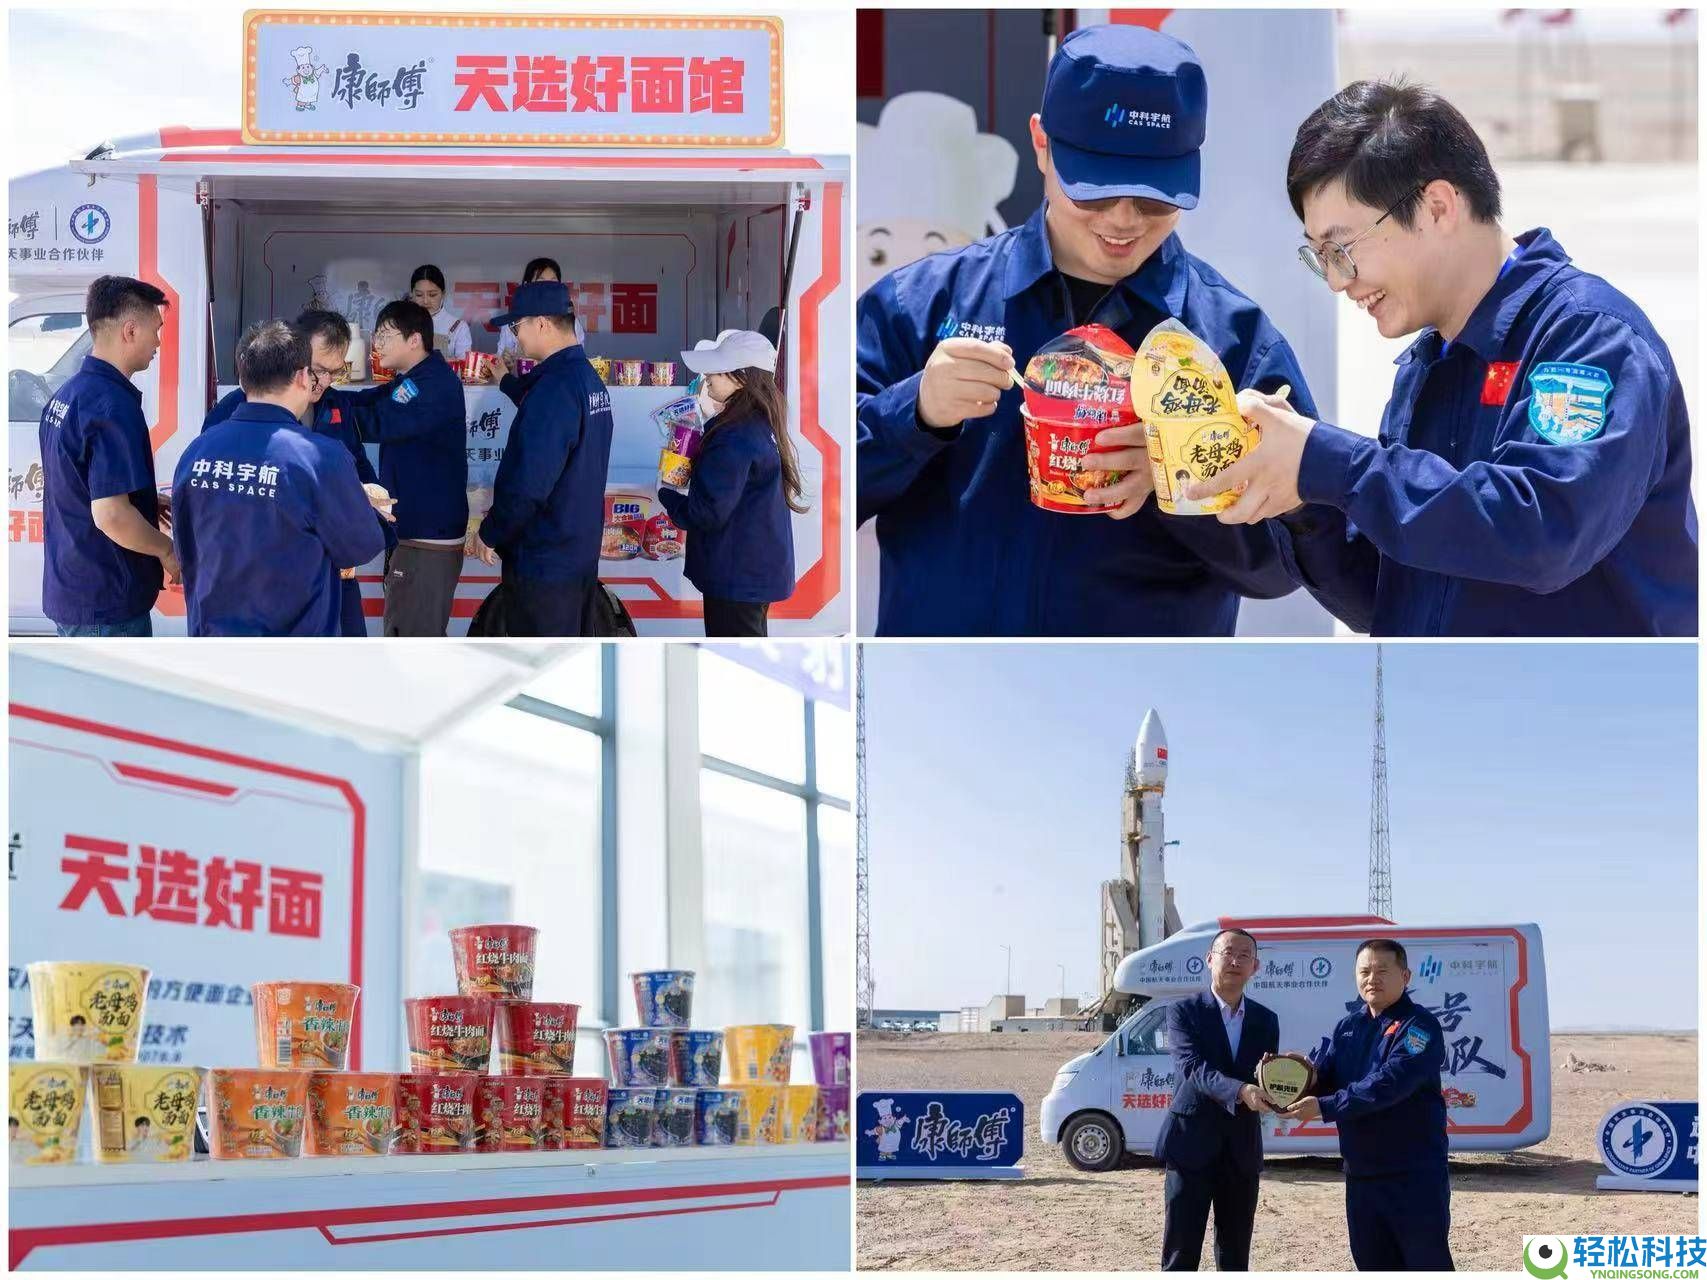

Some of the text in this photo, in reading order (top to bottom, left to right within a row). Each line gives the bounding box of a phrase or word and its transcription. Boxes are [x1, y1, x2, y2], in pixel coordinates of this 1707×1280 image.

[331, 53, 744, 114] 康師傅 天选好面馆
[1129, 110, 1171, 123] 中科宇航
[1147, 121, 1170, 129] SPACE
[961, 321, 1006, 336] 中科宇航
[1190, 438, 1243, 464] 老母鸡
[1049, 453, 1083, 471] 红烧
[192, 458, 280, 486] 中科宇航
[190, 478, 276, 498] CAS SPACE
[613, 504, 640, 513] BIG
[58, 833, 324, 939] 天选好面
[89, 990, 137, 1012] 老母鸡
[430, 1025, 486, 1038] 红烧牛肉面
[24, 1089, 76, 1111] 老母鸡
[1123, 1093, 1174, 1110] 天选好
